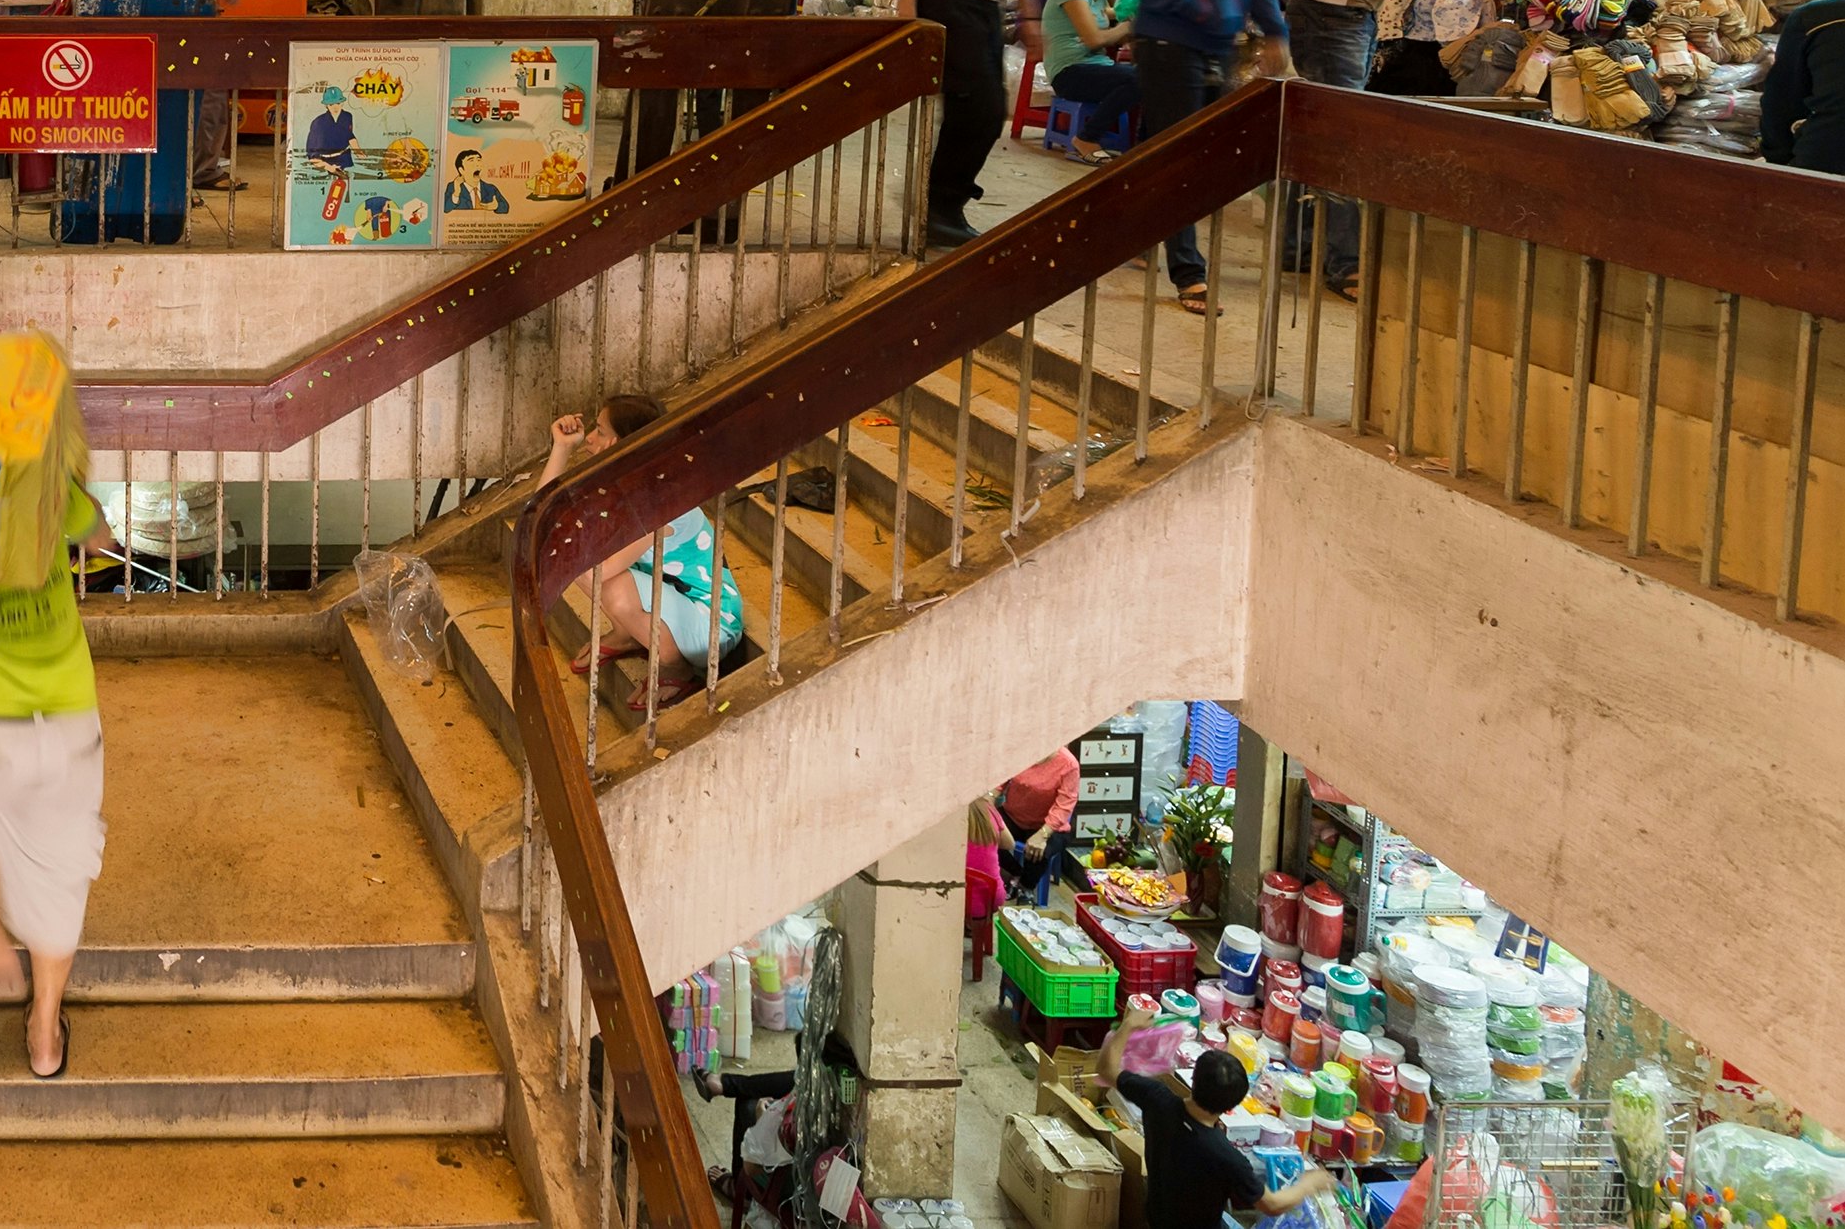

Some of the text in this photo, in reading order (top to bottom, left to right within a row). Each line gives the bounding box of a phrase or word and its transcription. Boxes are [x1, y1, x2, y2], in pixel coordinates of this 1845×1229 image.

[36, 90, 75, 119] HÚT
[82, 88, 149, 119] THUỐC
[10, 126, 125, 144] NO SMOKING
[376, 172, 384, 180] 2
[320, 187, 325, 195] 1
[399, 225, 407, 233] 3
